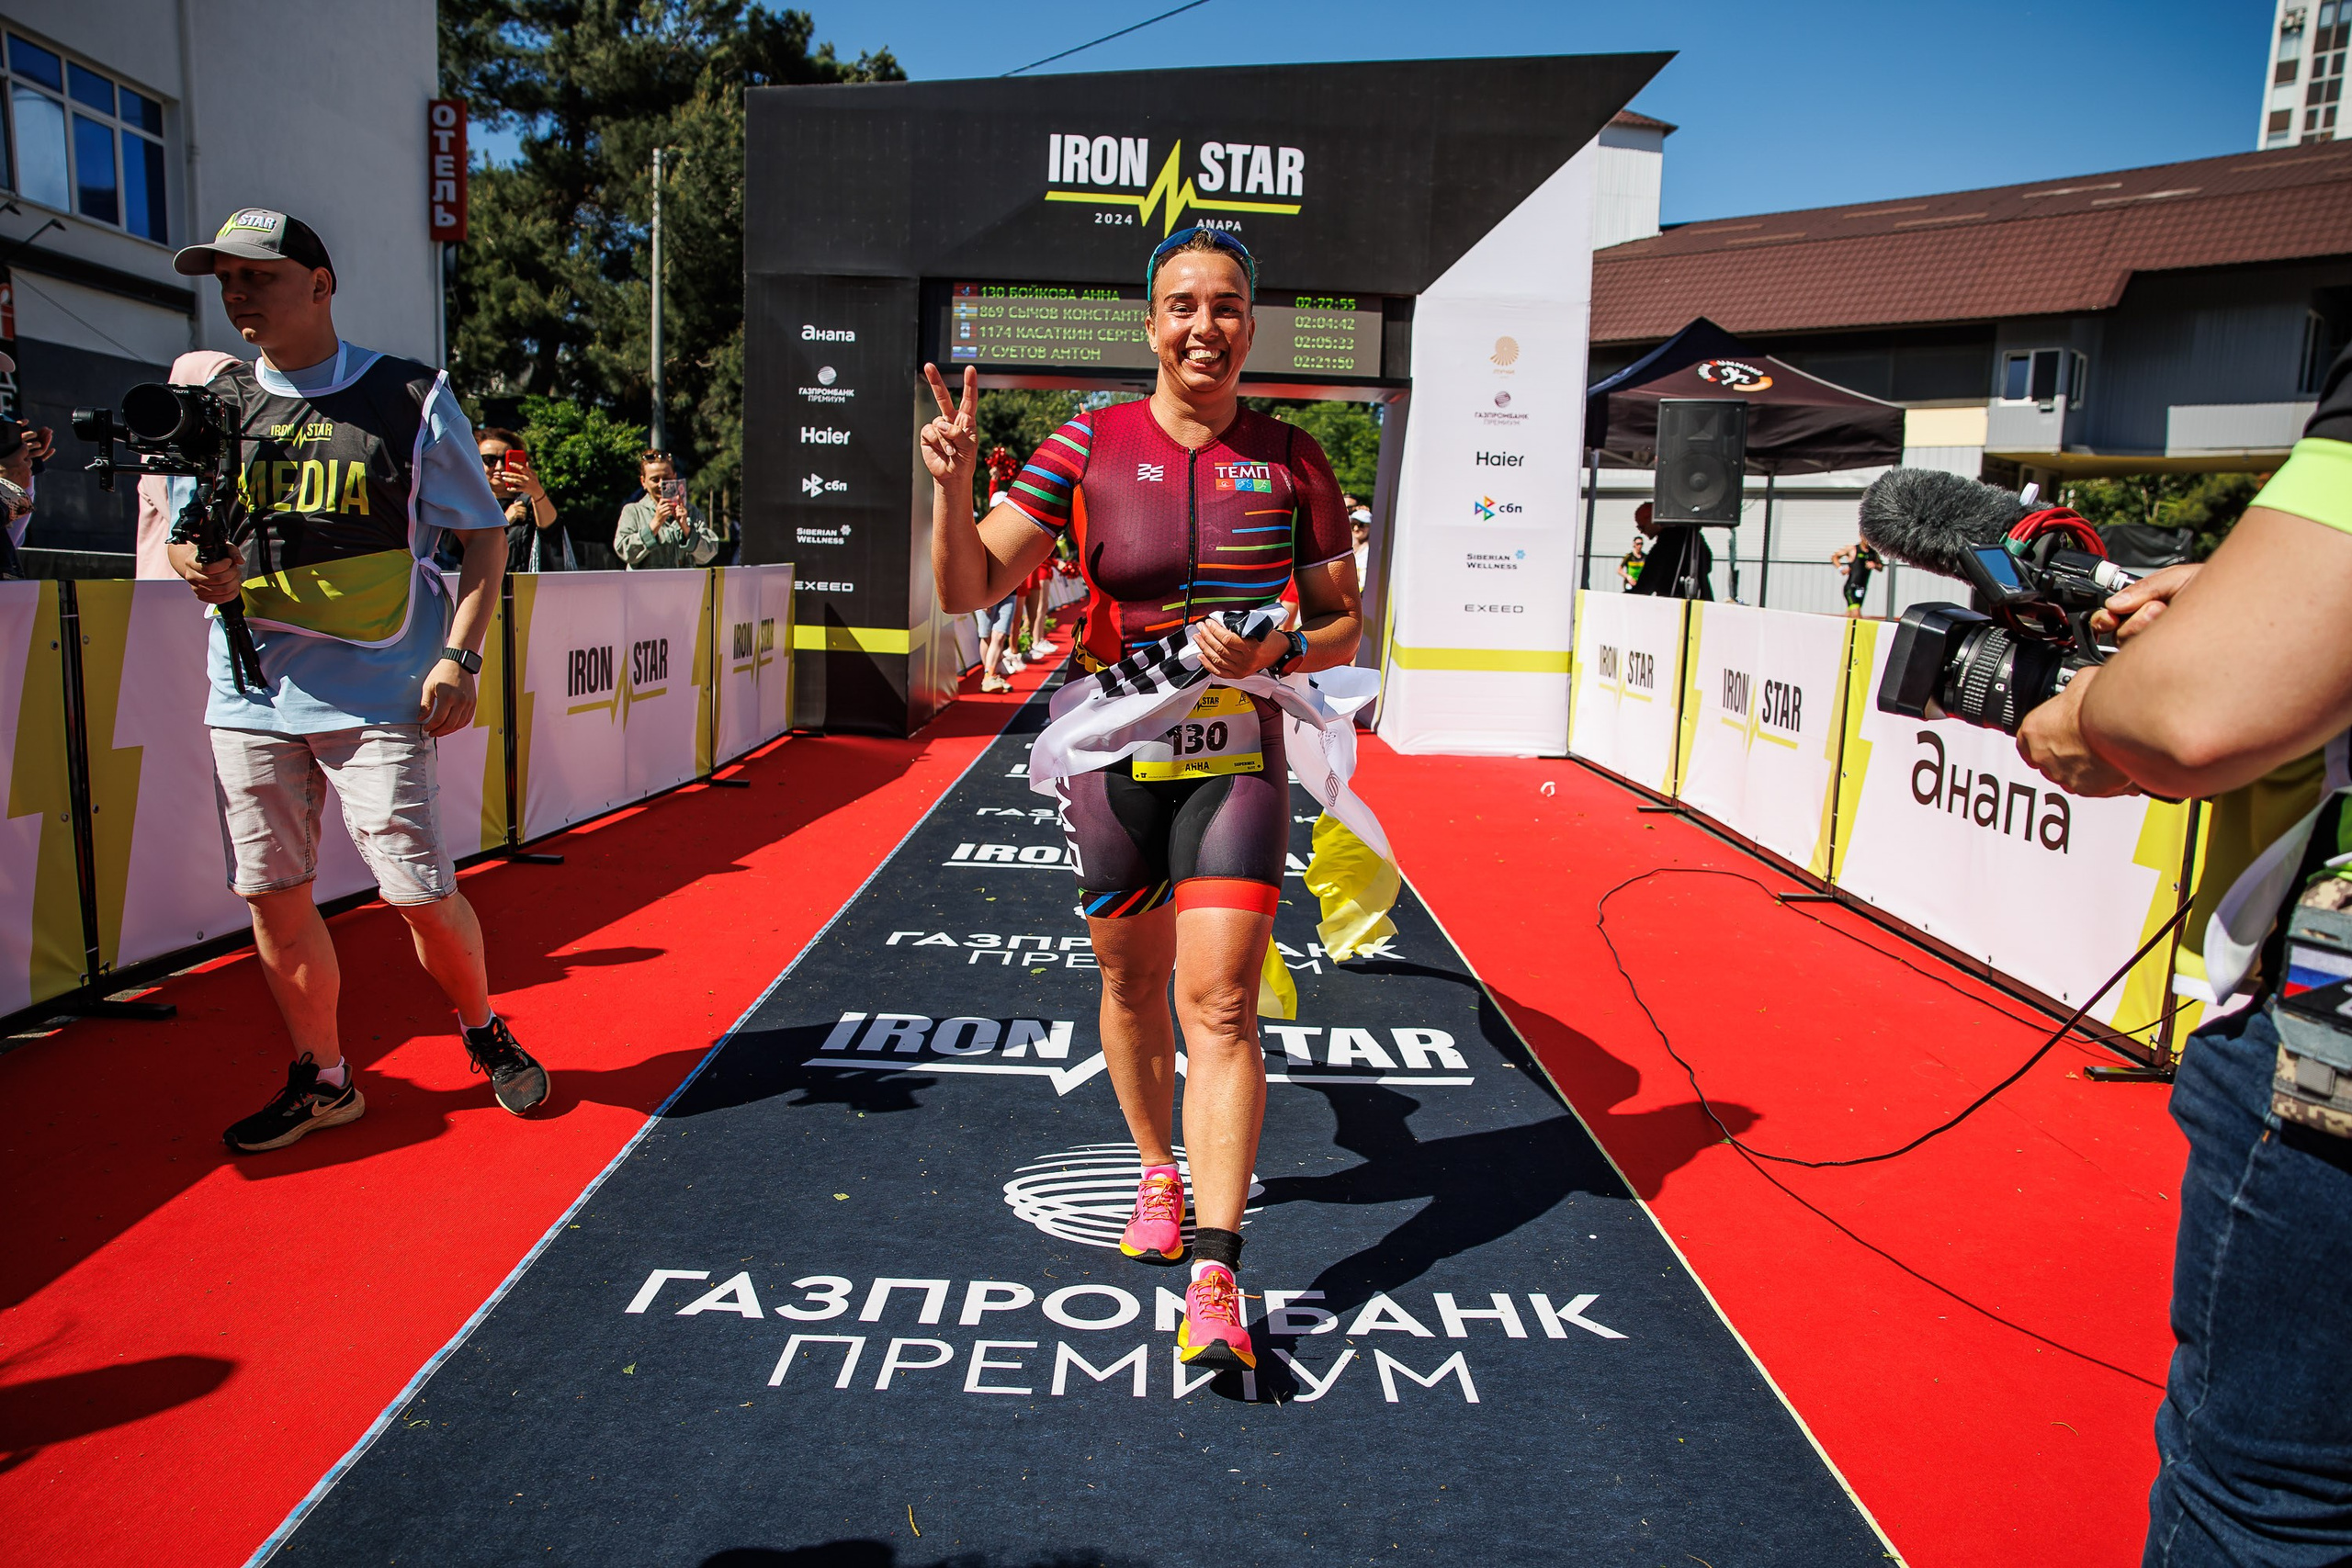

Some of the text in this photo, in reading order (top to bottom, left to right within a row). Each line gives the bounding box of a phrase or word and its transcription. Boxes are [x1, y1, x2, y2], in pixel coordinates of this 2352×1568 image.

[433, 105, 457, 227] ОТЕЛЬ
[1048, 133, 1305, 196] IRON STAR
[239, 214, 276, 230] STAR
[1094, 212, 1133, 225] 2024
[1196, 219, 1242, 231] ANAPA
[981, 287, 1005, 299] 130
[1080, 289, 1120, 301] АННА
[979, 305, 1004, 319] 869
[1009, 306, 1058, 320] СЫЧОВ
[1295, 315, 1355, 331] 02:04:42
[979, 325, 1012, 338] 1174
[1016, 326, 1093, 340] КАСАТКИН
[1294, 335, 1354, 350] 02:05:33
[978, 344, 988, 357] 7
[991, 344, 1046, 359] СУЕТОВ
[1050, 346, 1101, 360] АНТОН
[798, 387, 855, 397] ГАЗПРОМБАНК
[307, 423, 333, 436] STAR
[801, 426, 851, 445] Haier
[1476, 451, 1524, 467] Haier
[1215, 466, 1271, 479] ТЕМП
[238, 458, 370, 515] MEDIA
[824, 480, 847, 491] сбп
[1498, 502, 1522, 513] сбп
[794, 581, 854, 592] EXEED
[1464, 604, 1523, 613] EXEED
[733, 617, 775, 660] IRON STAR
[568, 638, 668, 697] IRON STAR
[1600, 644, 1654, 689] IRON STAR
[1202, 696, 1219, 705] STAR
[1723, 668, 1802, 732] IRON STAR
[1165, 720, 1228, 756] 130
[1185, 761, 1209, 772] АННА
[950, 842, 1073, 864] IRO
[820, 1012, 1469, 1069] IRON TAR
